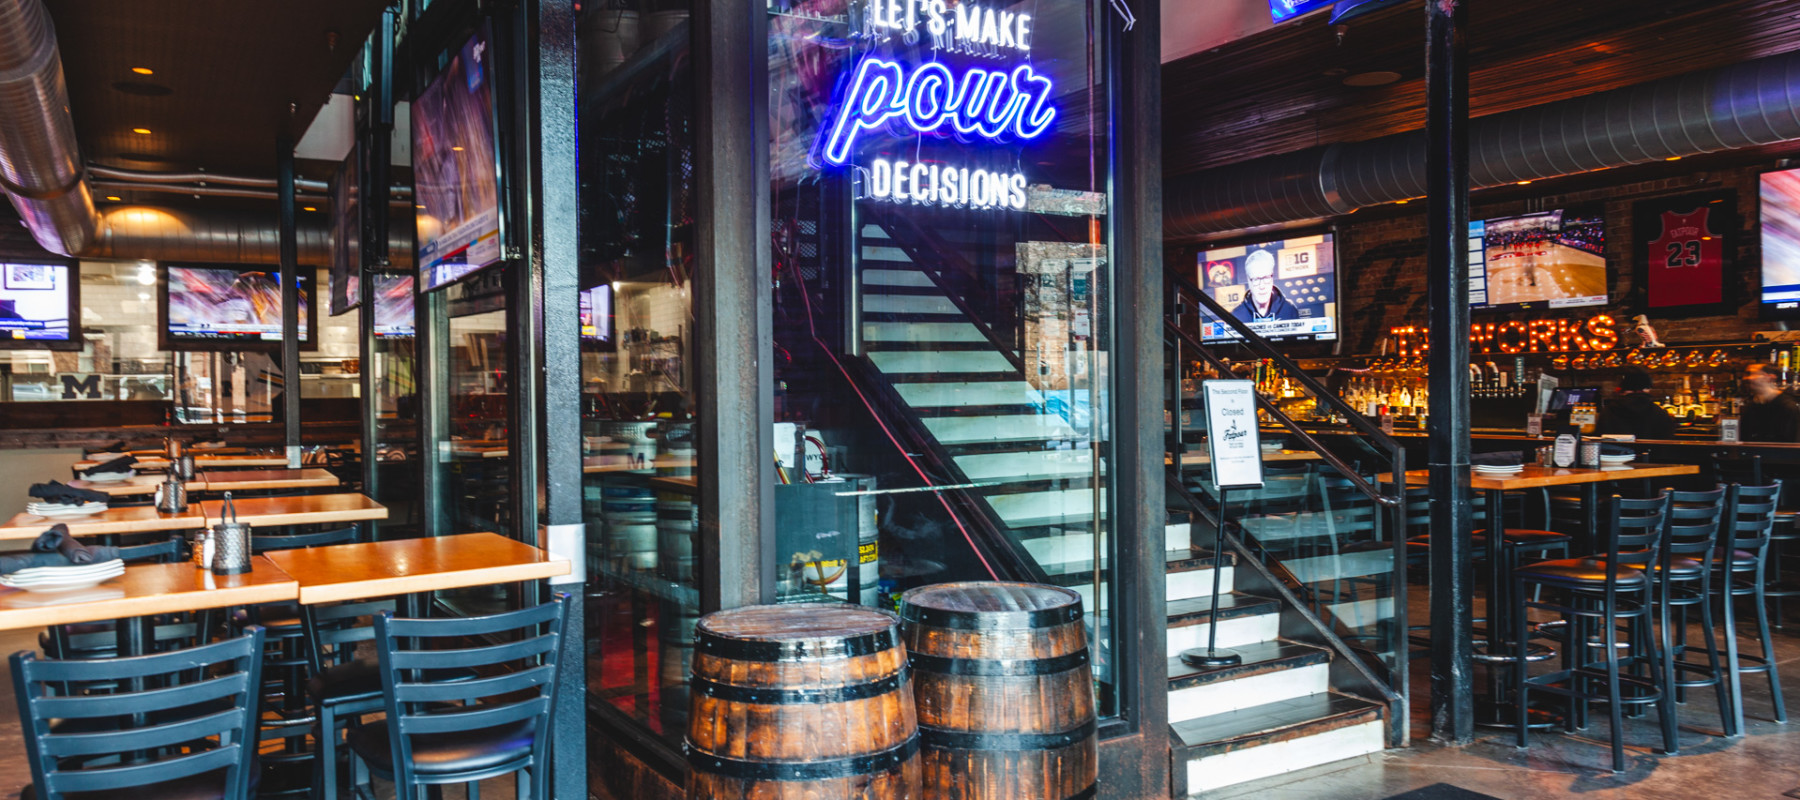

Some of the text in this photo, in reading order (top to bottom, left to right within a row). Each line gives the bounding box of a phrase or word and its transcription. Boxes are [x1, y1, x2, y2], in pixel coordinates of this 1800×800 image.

[874, 0, 1031, 50] LET'S MAKE
[826, 58, 1056, 164] pour
[872, 158, 1027, 209] DECISIONS
[1666, 240, 1702, 267] 23
[61, 375, 101, 399] M
[1222, 407, 1244, 417] Closed
